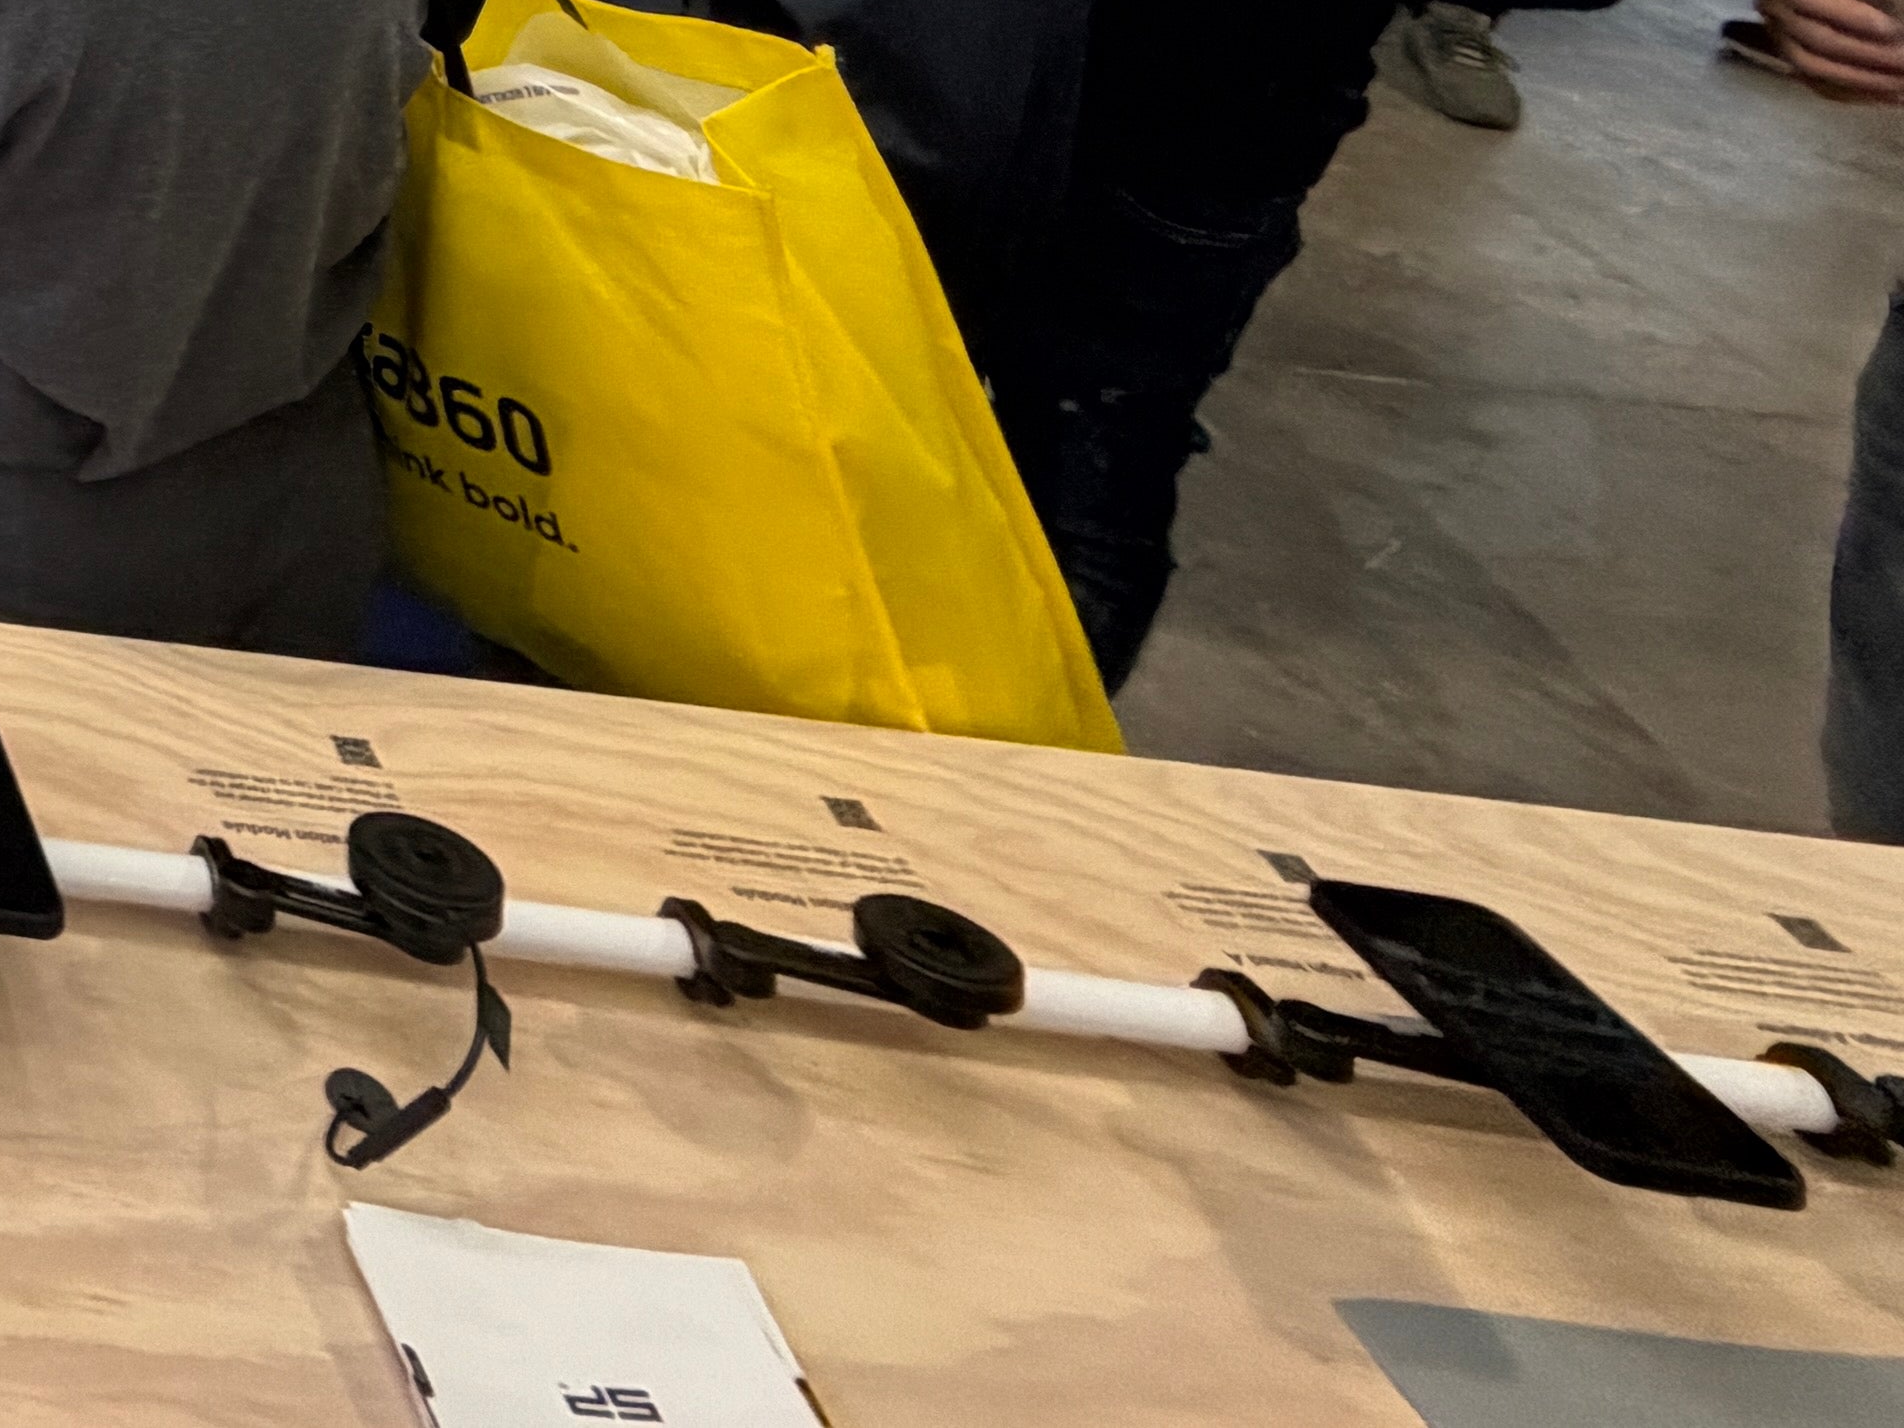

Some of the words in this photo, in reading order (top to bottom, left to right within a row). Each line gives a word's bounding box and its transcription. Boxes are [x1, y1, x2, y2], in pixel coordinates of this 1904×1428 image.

[370, 326, 553, 477] a360
[391, 436, 453, 494] ink
[461, 472, 580, 554] bold.
[295, 828, 342, 844] ation
[562, 1384, 665, 1424] SP
